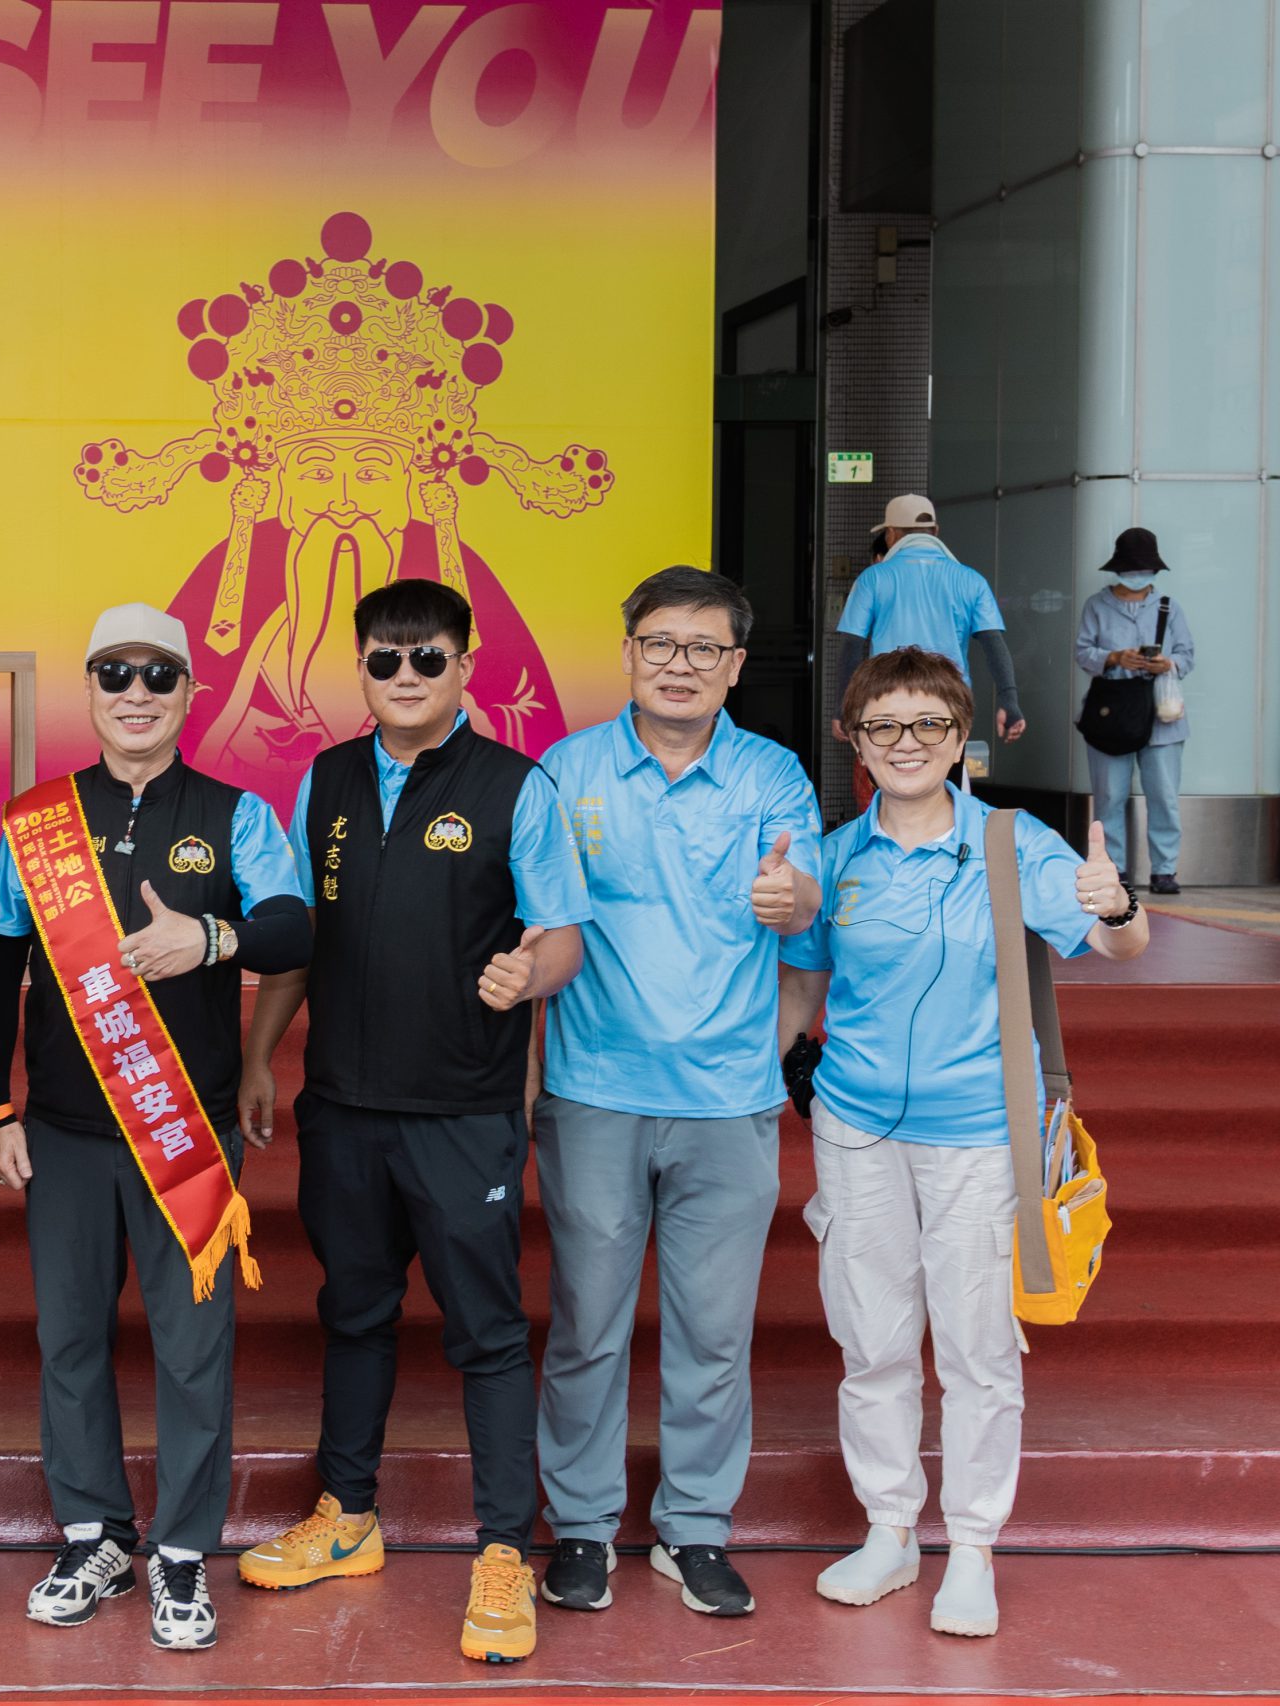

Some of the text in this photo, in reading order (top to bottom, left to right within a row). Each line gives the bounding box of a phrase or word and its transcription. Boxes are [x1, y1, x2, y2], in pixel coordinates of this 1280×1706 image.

[321, 4, 722, 168] YOU
[13, 801, 70, 835] 2025
[18, 815, 72, 842] TU DI GONG
[49, 829, 95, 908] 土地公
[77, 962, 195, 1162] 車城福安宮
